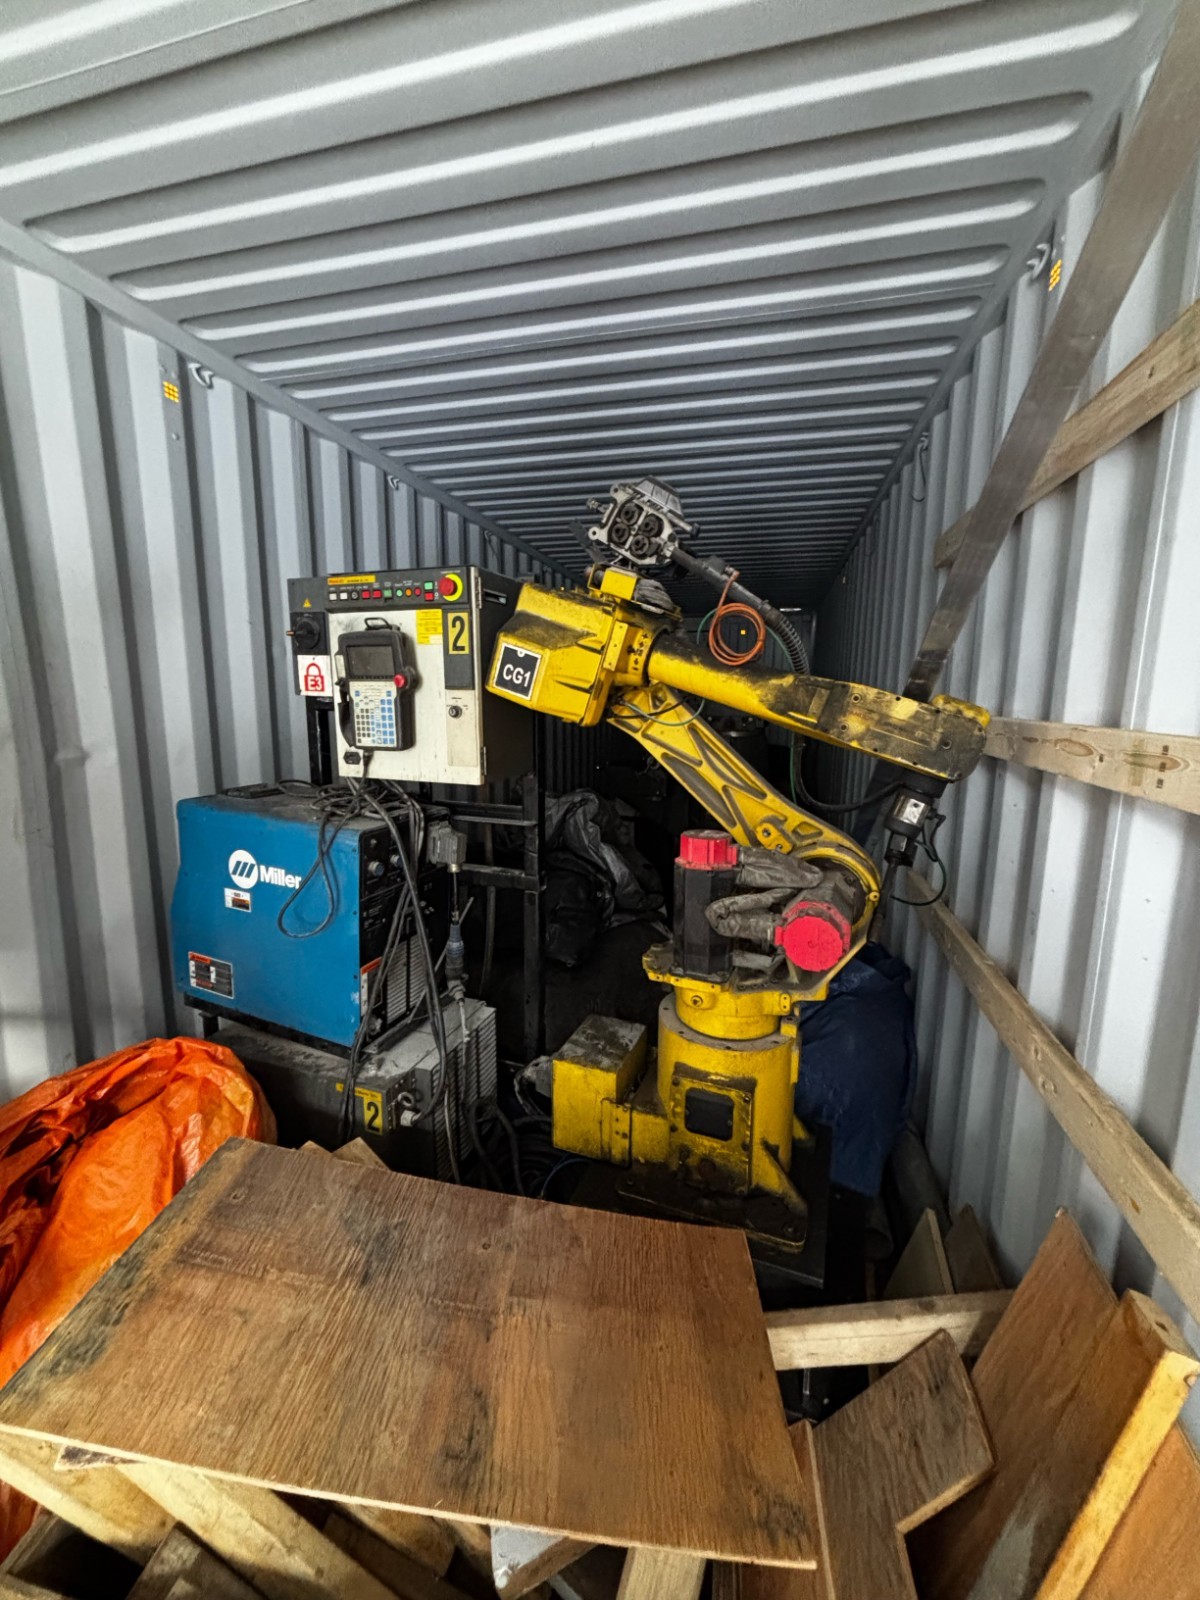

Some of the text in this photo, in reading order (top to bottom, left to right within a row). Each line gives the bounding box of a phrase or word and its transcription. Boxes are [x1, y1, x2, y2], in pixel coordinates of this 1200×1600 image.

[452, 615, 466, 652] 2
[308, 676, 323, 691] E3
[502, 663, 532, 688] CG1
[260, 864, 302, 890] Miller
[366, 1101, 380, 1132] 2
